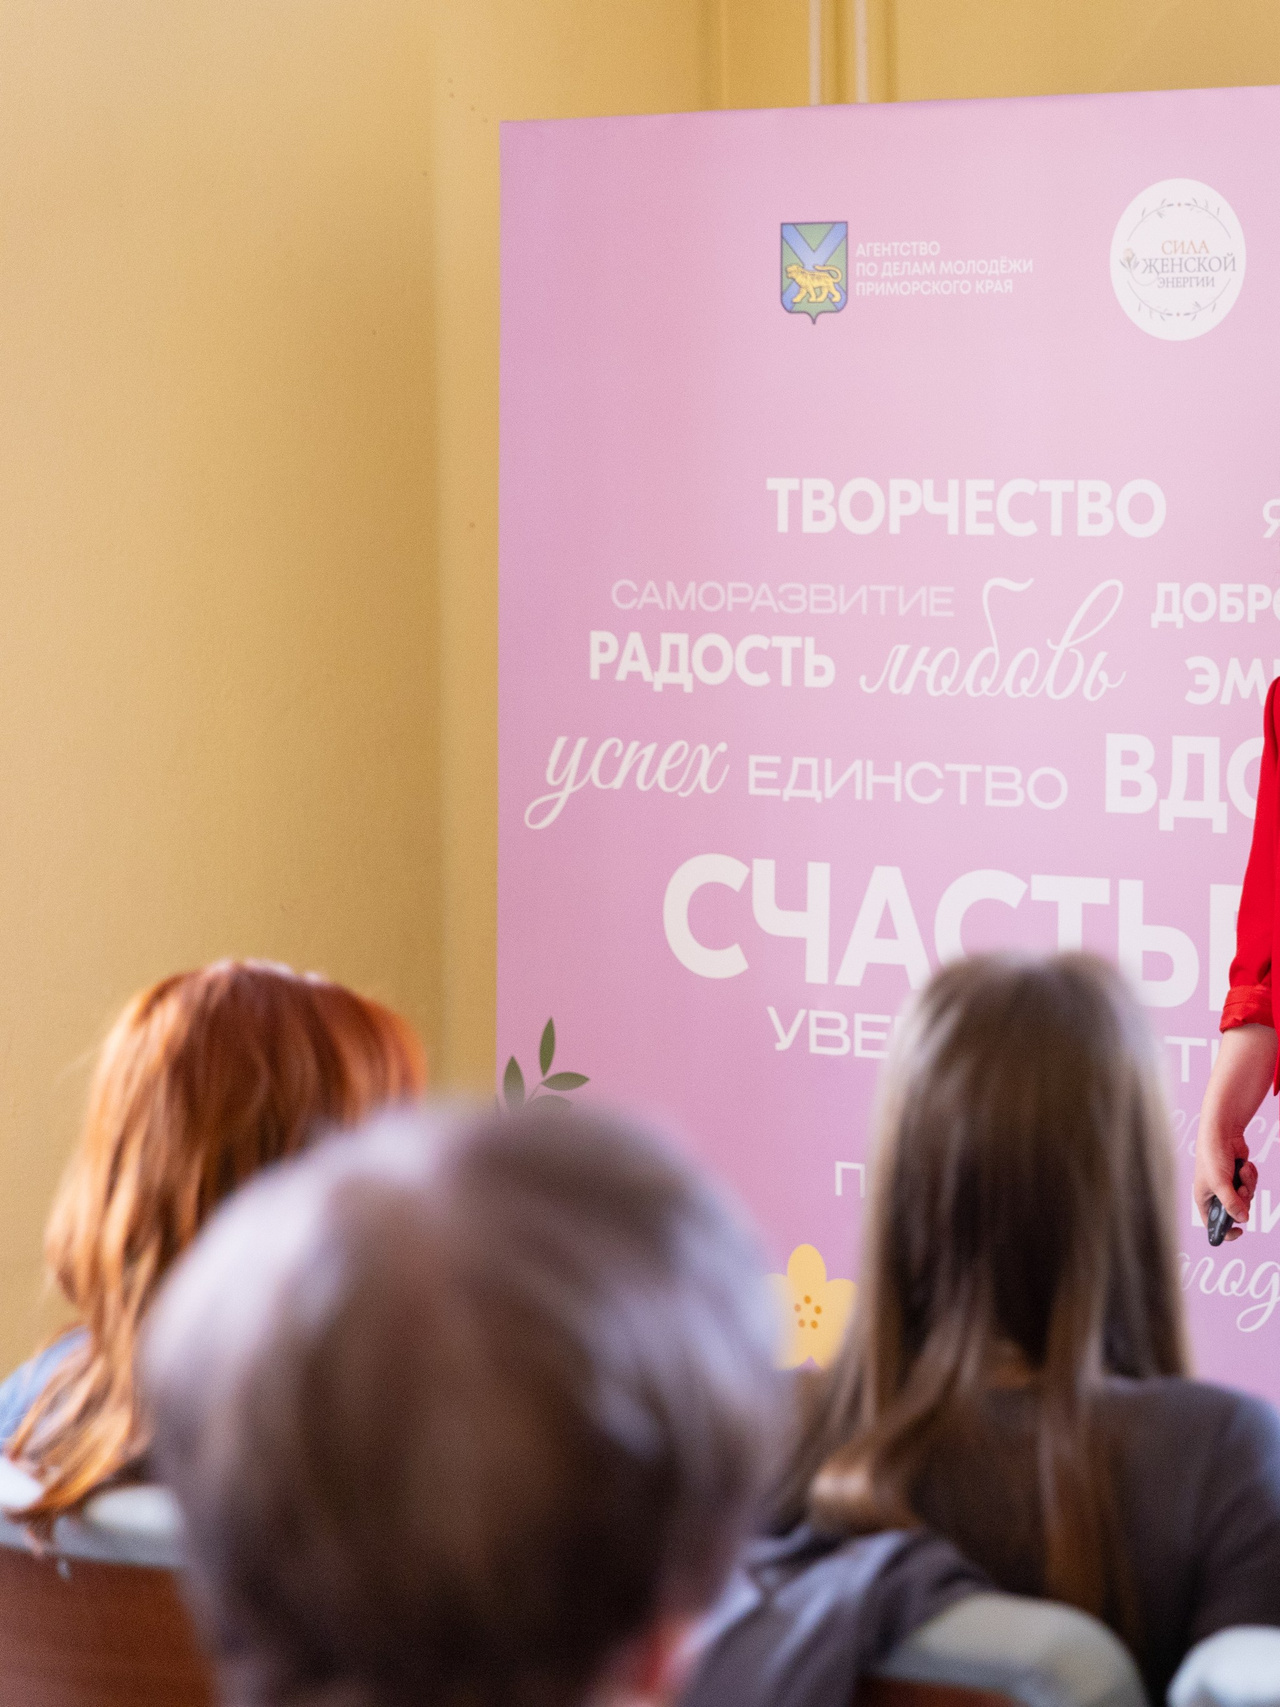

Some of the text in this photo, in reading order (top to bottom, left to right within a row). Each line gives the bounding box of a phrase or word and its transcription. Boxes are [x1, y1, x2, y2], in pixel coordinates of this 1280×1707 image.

[856, 241, 940, 257] АГЕНТСТВО
[1161, 240, 1210, 255] СИЛА
[856, 256, 1033, 277] ПО ДЕЛАМ МОЛОДЁЖИ
[1141, 252, 1237, 274] ЖЕНСКОЙ
[856, 279, 1012, 295] ПРИМОРСКОГО КРАЯ
[1157, 276, 1215, 289] ЭНЕРГИИ
[767, 478, 1166, 538] ТВОРЧЕСТВО
[611, 579, 955, 617] САМОРАЗВИТИЕ
[857, 575, 1127, 702] любовь
[591, 632, 835, 692] РАДОСТЬ
[522, 732, 732, 832] успех
[750, 756, 1068, 810] ЕДИНСТВО
